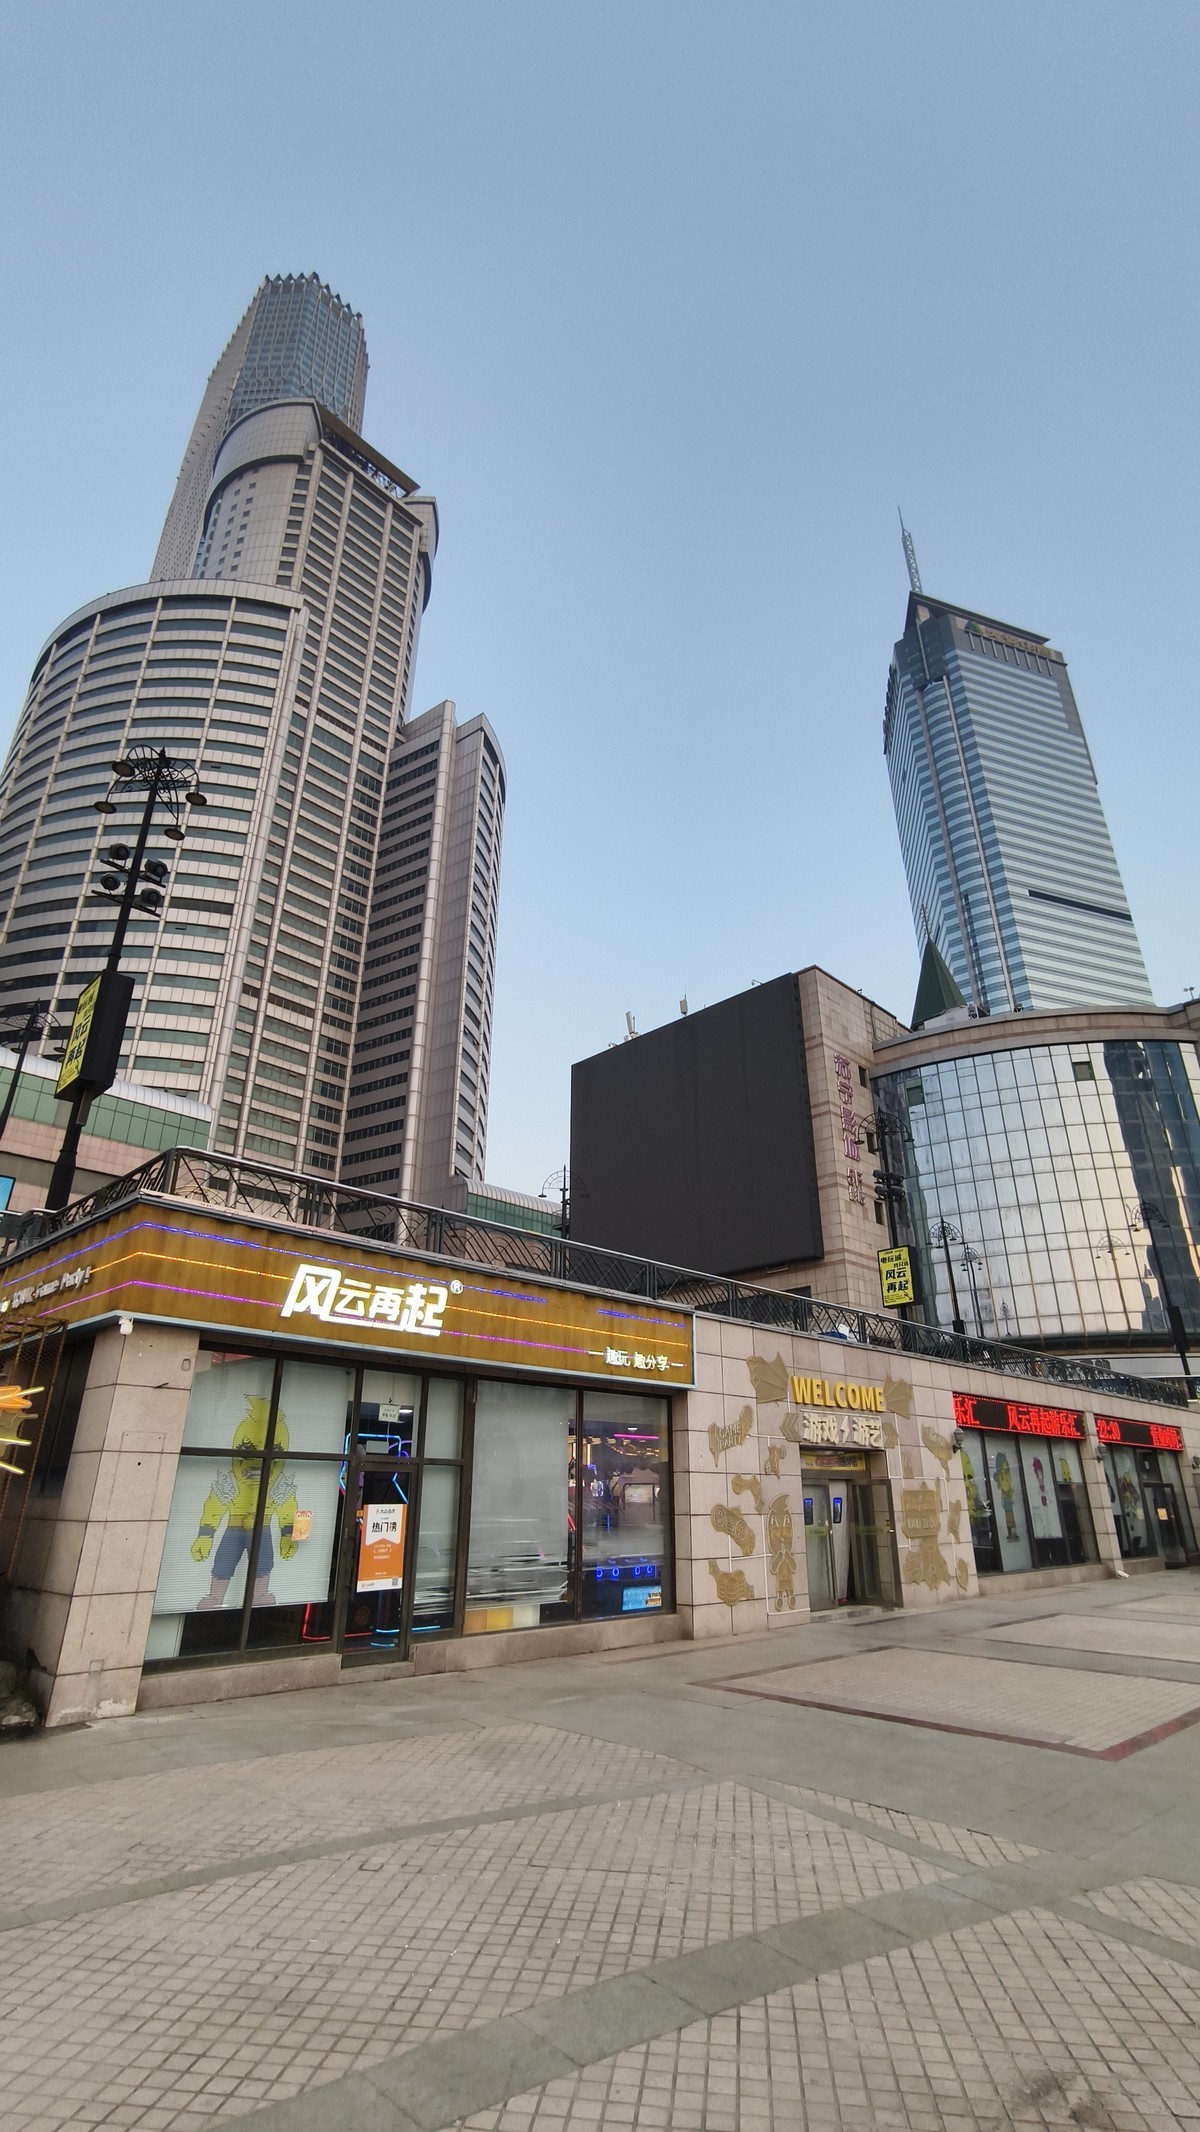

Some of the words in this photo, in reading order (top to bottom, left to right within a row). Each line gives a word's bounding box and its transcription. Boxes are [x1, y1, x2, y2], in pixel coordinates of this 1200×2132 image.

[885, 1267, 907, 1281] 风云
[886, 1280, 909, 1293] 再起
[280, 1263, 449, 1337] 风云再起
[605, 1346, 631, 1367] 趣玩
[633, 1351, 670, 1371] 趣分享
[791, 1375, 887, 1412] WELCOME
[719, 1421, 742, 1439] GAME
[803, 1412, 840, 1445] 游戏
[852, 1416, 883, 1448] 游艺
[953, 1396, 980, 1425] 乐汇
[1007, 1404, 1081, 1436] 风云再起游乐汇
